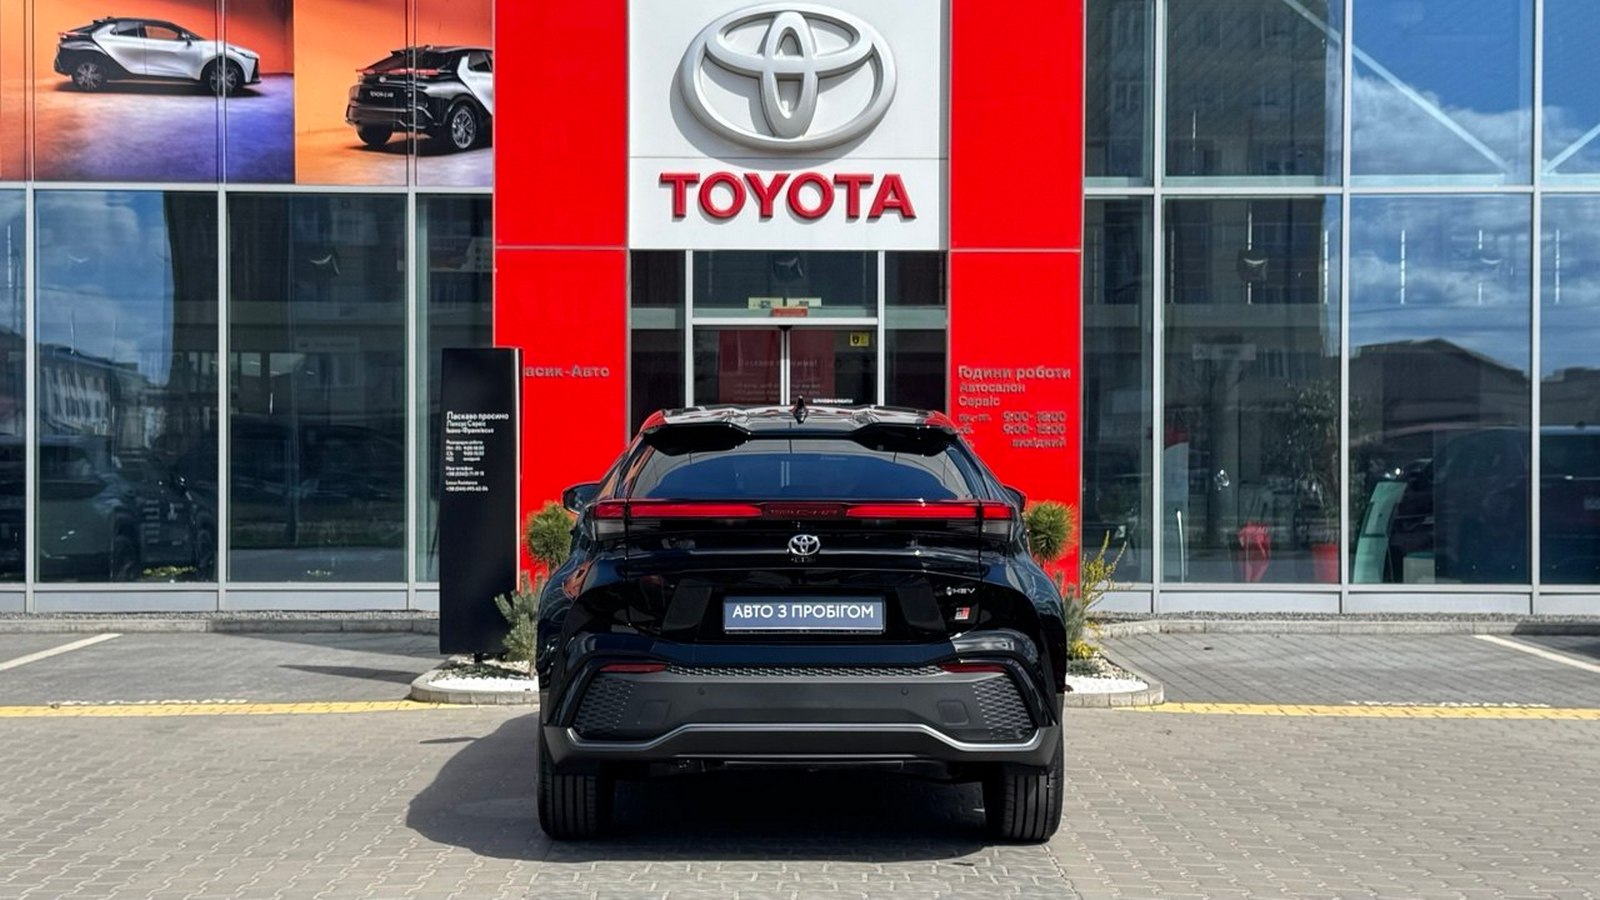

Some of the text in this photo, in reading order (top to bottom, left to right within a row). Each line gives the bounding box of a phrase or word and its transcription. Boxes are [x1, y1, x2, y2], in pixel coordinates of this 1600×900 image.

[659, 171, 917, 220] TOYOTA
[958, 364, 1071, 381] Години роботи
[959, 382, 1026, 394] Автосалон
[958, 395, 1001, 408] Сервіс
[732, 604, 875, 619] АВТО З ПРОБІГОМ
